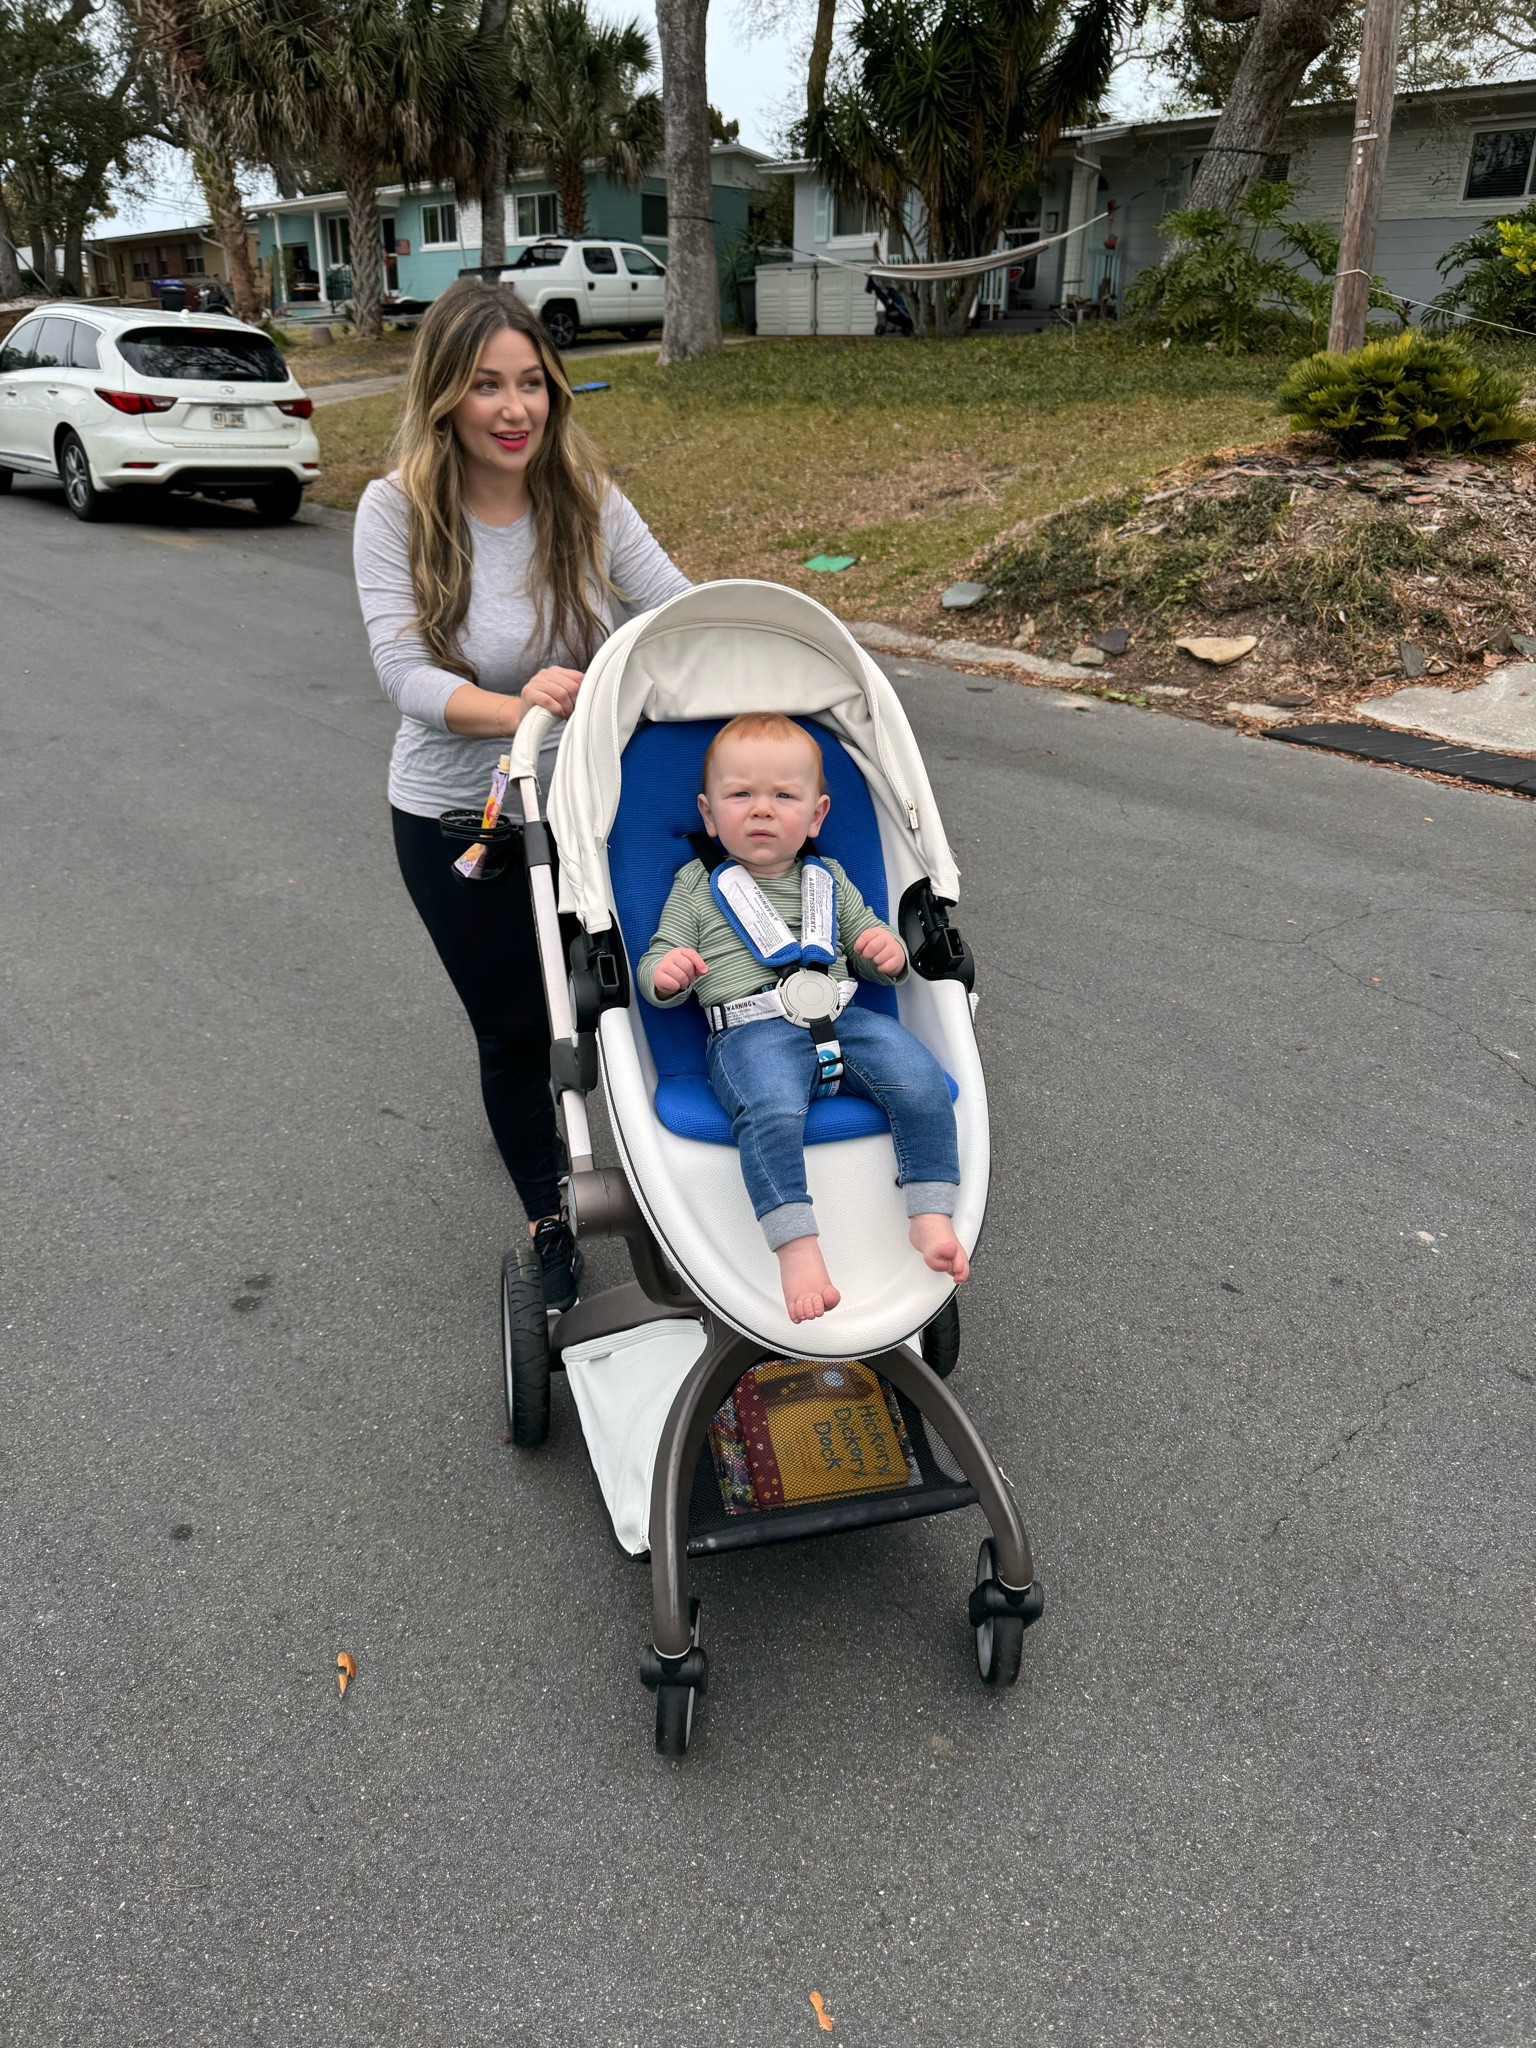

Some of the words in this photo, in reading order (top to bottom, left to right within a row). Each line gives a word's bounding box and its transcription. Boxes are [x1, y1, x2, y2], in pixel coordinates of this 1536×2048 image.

[755, 889, 775, 918] WARNING
[726, 1000, 752, 1011] WARNING
[813, 1420, 844, 1472] Dock
[834, 1406, 868, 1480] Dickory
[857, 1405, 889, 1475] Hickory
